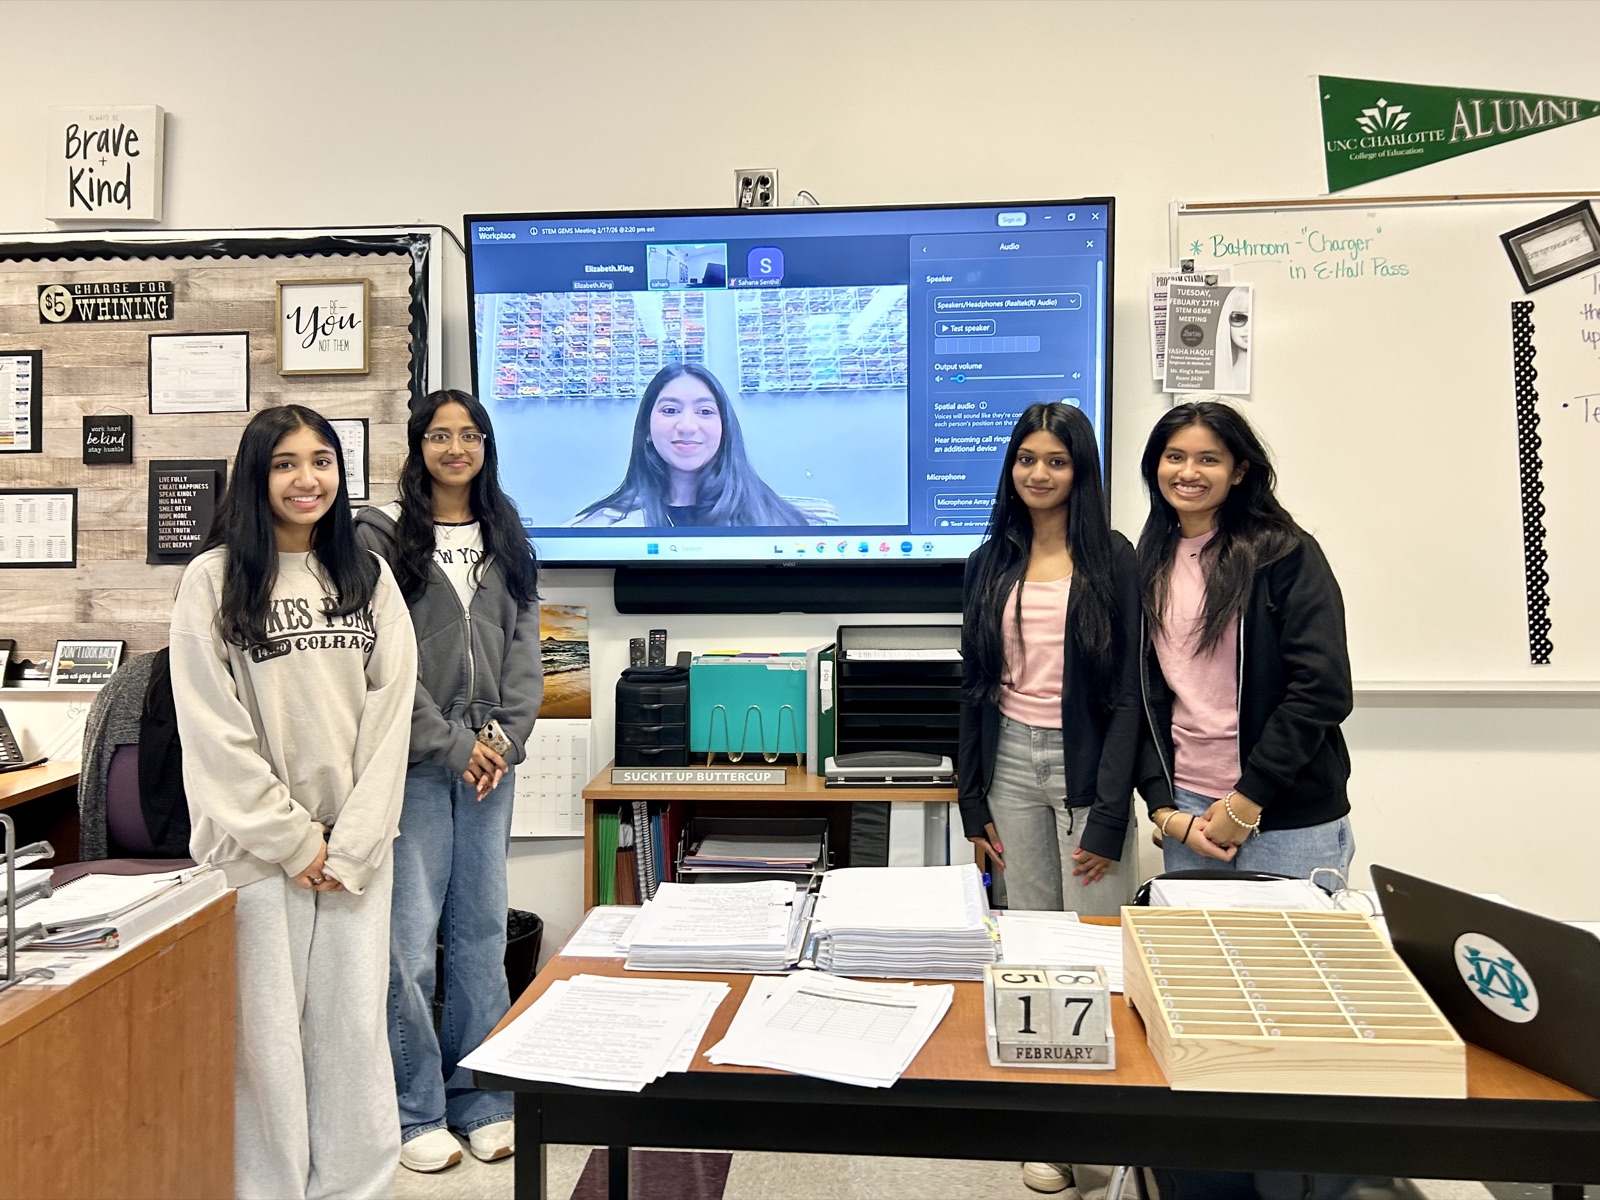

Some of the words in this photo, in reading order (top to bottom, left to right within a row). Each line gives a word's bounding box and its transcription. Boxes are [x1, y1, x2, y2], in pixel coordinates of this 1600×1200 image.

[1448, 98, 1582, 144] ALUMNI
[65, 123, 140, 160] Brave
[1327, 138, 1358, 152] UNC
[1360, 129, 1446, 149] CHARLOTTE
[1349, 150, 1377, 161] College
[1378, 148, 1386, 158] of
[1387, 147, 1425, 157] Education
[69, 161, 131, 211] Kind
[478, 231, 516, 241] Workplace
[574, 227, 597, 236] Meeting
[597, 226, 619, 234] 2/17/26
[637, 226, 646, 234] pm
[1000, 243, 1020, 251] Audio
[1209, 234, 1290, 258] Bathroom
[584, 264, 634, 274] Elizabeth.King
[760, 257, 772, 274] S
[1289, 259, 1307, 280] in
[1371, 257, 1410, 278] Pass
[926, 275, 953, 284] Speaker
[573, 282, 613, 290] Elizabeth.King
[1177, 288, 1211, 298] TUESDAY,
[45, 291, 66, 317] $5
[75, 282, 130, 295] CHARGE
[140, 281, 166, 293] FOR
[937, 300, 1004, 310] Speakers/Headphones
[1037, 298, 1058, 307] Audio)
[1170, 298, 1201, 306] FEBUARY
[1201, 299, 1220, 307] 17TH
[75, 295, 169, 321] WHINING
[329, 299, 338, 315] BE
[1175, 306, 1192, 314] STEM
[1192, 307, 1212, 315] GEMS
[1178, 315, 1207, 323] MEETING
[286, 305, 362, 349] You
[950, 324, 963, 332] Test
[964, 323, 991, 334] speaker
[318, 339, 330, 352] NOT
[333, 338, 350, 352] THEM
[1190, 349, 1214, 357] HAQUE
[934, 363, 957, 372] Output
[958, 362, 983, 370] volume
[934, 402, 956, 411] Spatial
[956, 402, 975, 410] audio
[952, 412, 963, 420] will
[992, 411, 1011, 420] they're
[934, 420, 948, 428] each
[948, 420, 971, 429] person's
[972, 419, 995, 428] position
[86, 432, 100, 445] be
[100, 431, 126, 447] kind
[934, 436, 950, 445] Hear
[951, 435, 981, 445] incoming
[982, 435, 993, 443] call
[88, 446, 102, 454] stay
[944, 445, 975, 453] additional
[976, 444, 998, 452] device
[926, 473, 966, 482] Microphone
[937, 498, 973, 507] Microphone
[973, 498, 991, 507] Array
[81, 646, 99, 659] LOOK
[624, 772, 658, 782] SUCK
[661, 772, 673, 782] IT
[677, 772, 694, 782] UP
[697, 772, 771, 782] BUTTERCUP
[1016, 1047, 1093, 1060] FEBRUARY
